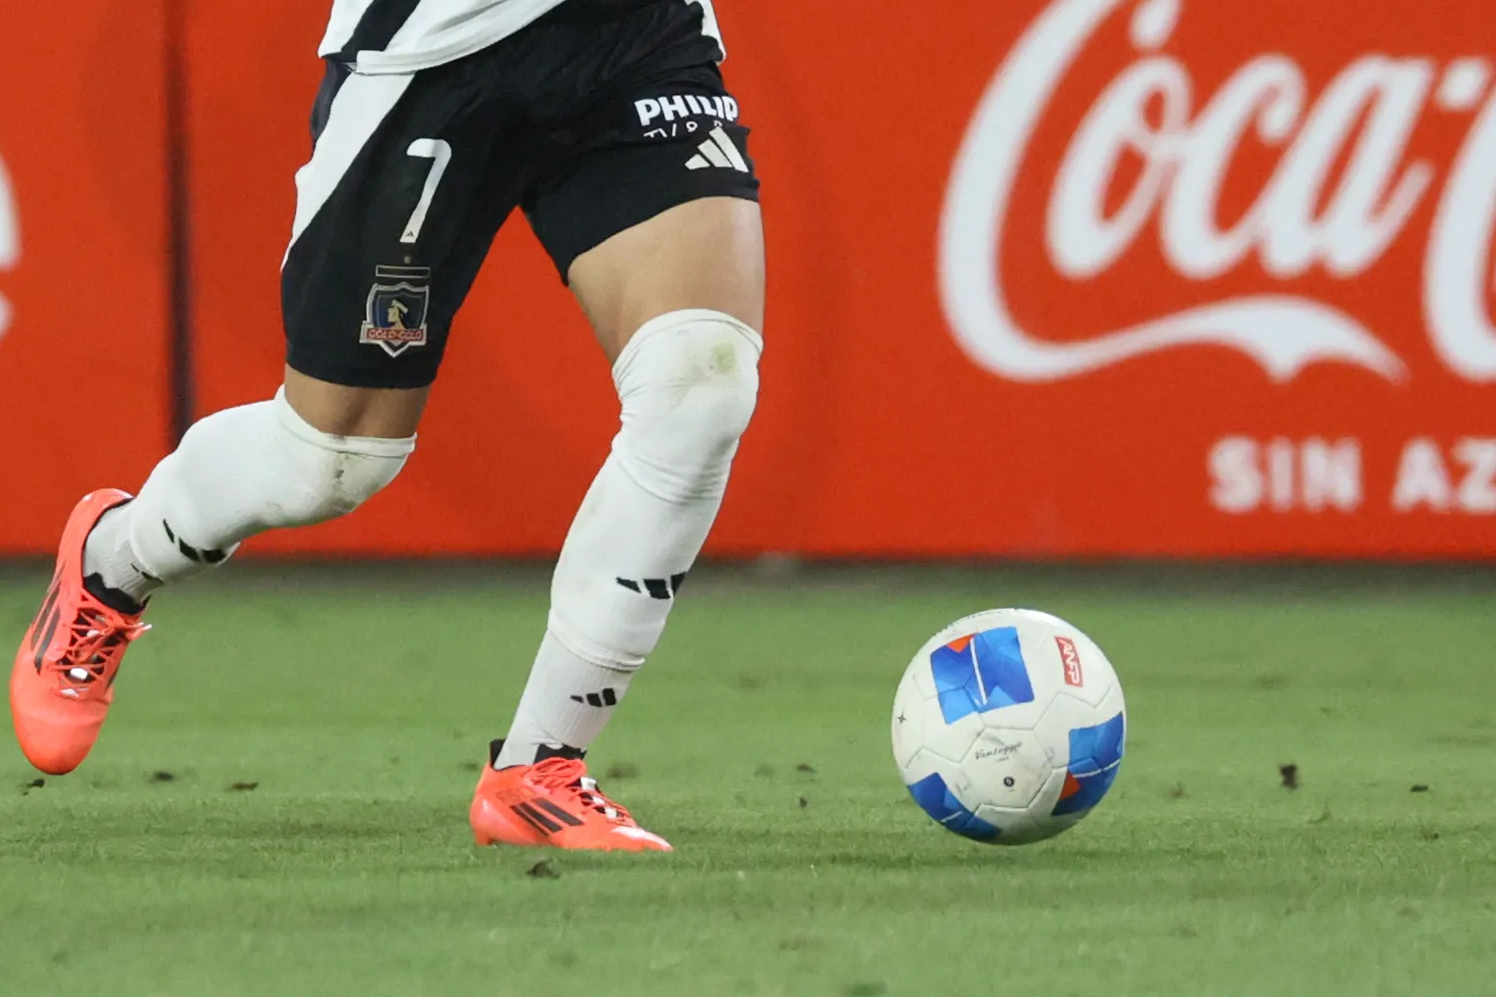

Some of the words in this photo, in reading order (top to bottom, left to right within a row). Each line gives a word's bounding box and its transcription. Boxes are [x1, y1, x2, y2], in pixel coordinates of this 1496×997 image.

[400, 138, 452, 243] 7
[1208, 436, 1364, 514] SIN
[1060, 639, 1081, 685] ANFP
